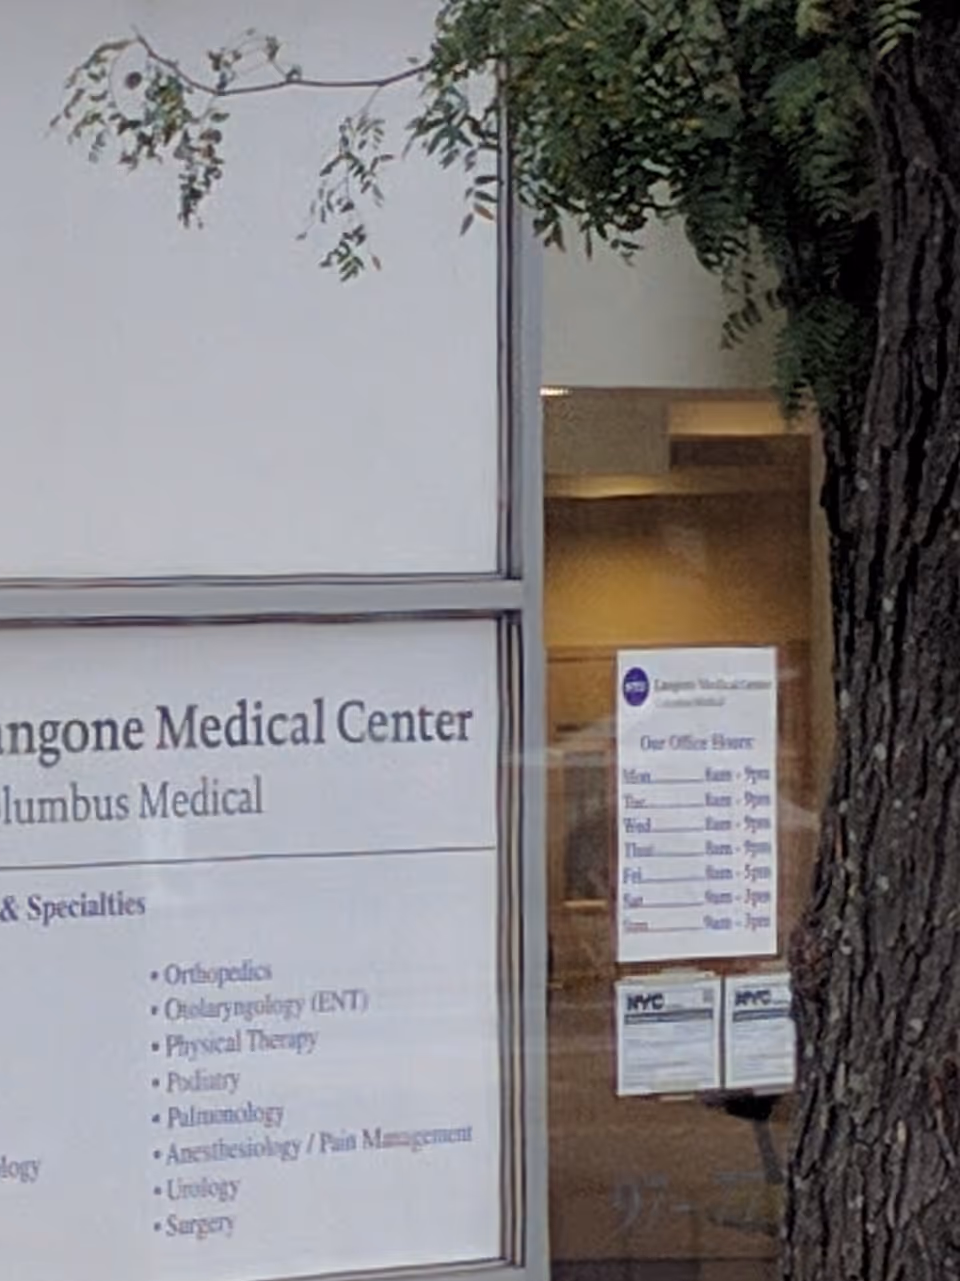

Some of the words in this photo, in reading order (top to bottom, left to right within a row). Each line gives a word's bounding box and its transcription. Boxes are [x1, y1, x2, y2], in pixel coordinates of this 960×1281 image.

[155, 698, 325, 752] Medical
[337, 699, 473, 747] Center
[640, 735, 666, 751] Our
[669, 734, 708, 751] Office
[138, 775, 264, 819] Medical
[27, 890, 146, 926] Specialties
[164, 959, 273, 988] Orthopedics
[311, 988, 369, 1014] (ENT)
[626, 992, 665, 1011] NYC
[166, 1029, 242, 1061] Physical
[245, 1028, 319, 1055] Therapy
[166, 1067, 240, 1095] Podiatry
[168, 1101, 284, 1129] Pulmonology
[166, 1135, 302, 1166] Anesthesiology
[319, 1129, 357, 1155] Pain
[361, 1124, 473, 1152] Management
[167, 1176, 241, 1203] Urology
[166, 1213, 236, 1241] Surgery
